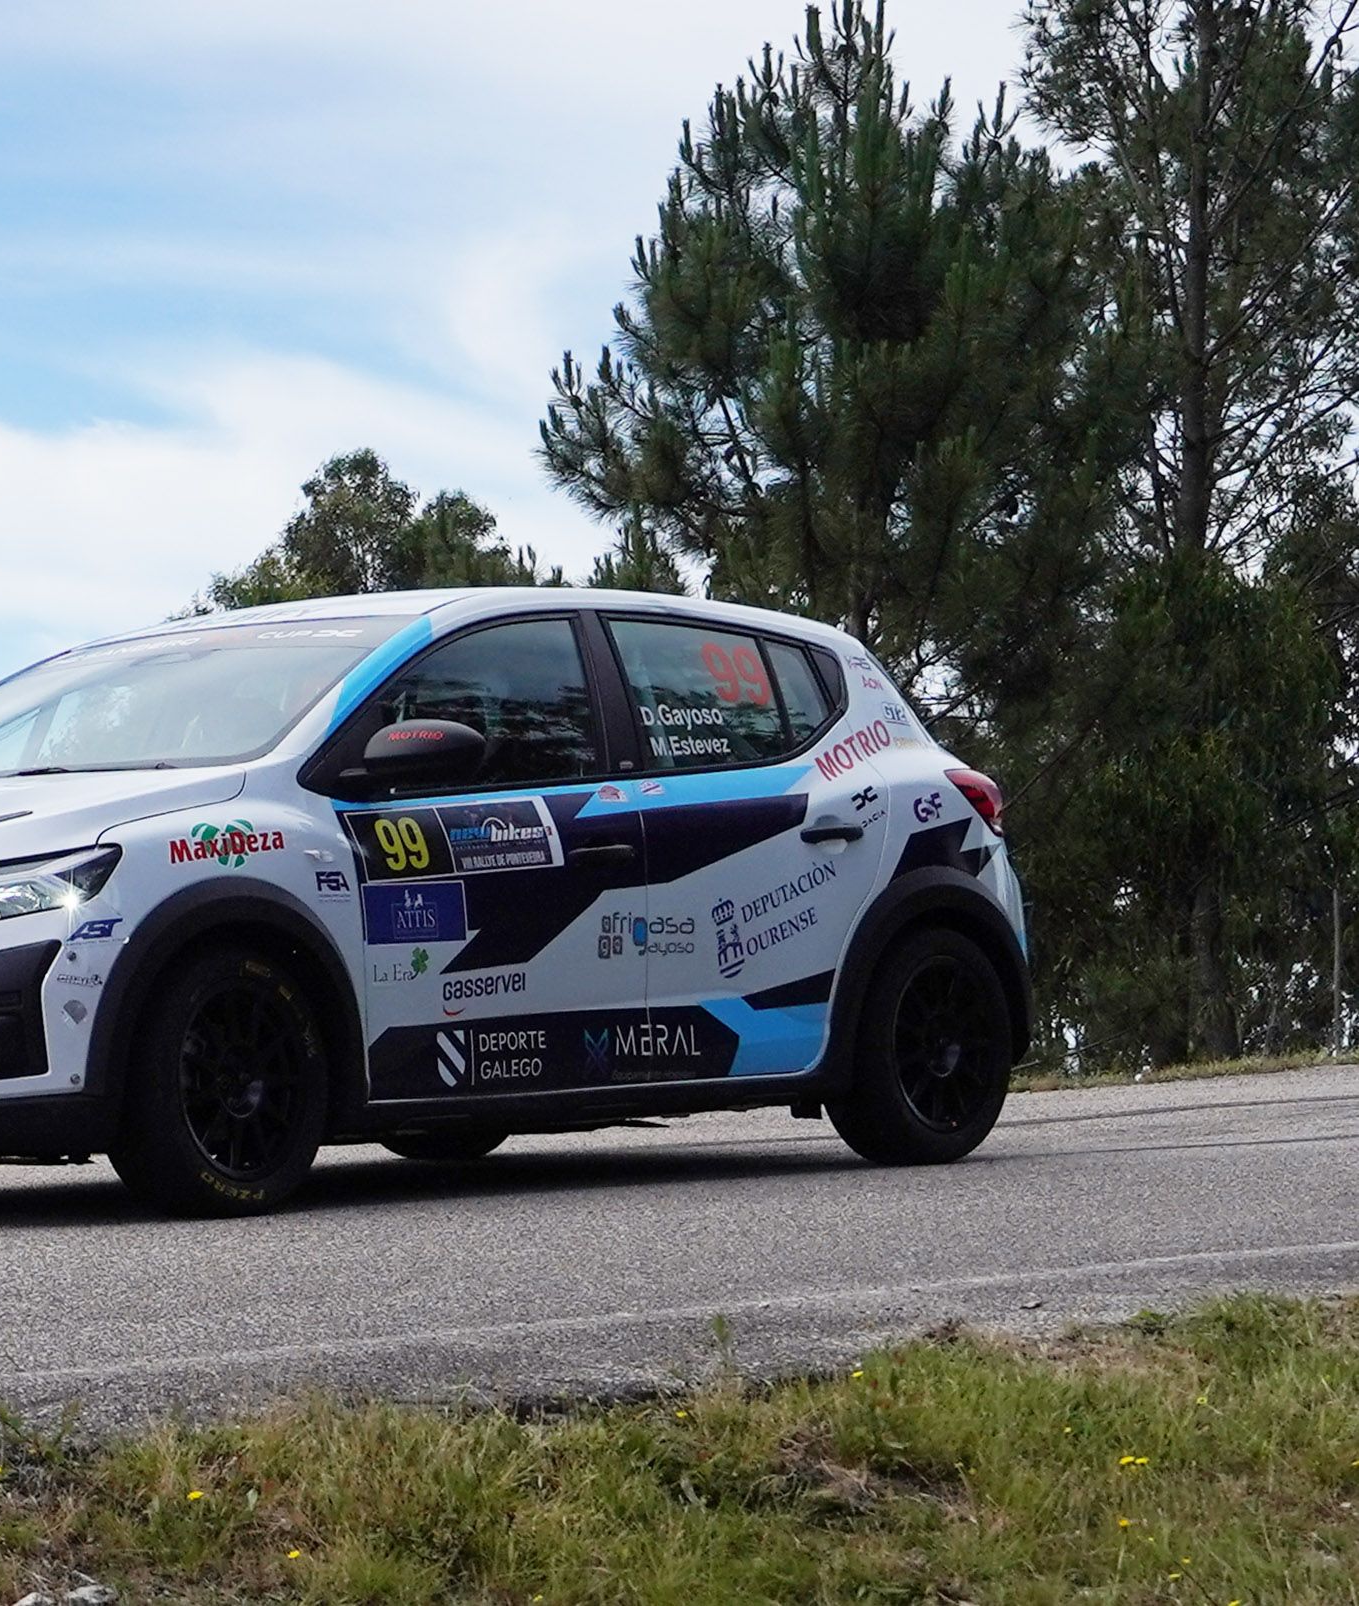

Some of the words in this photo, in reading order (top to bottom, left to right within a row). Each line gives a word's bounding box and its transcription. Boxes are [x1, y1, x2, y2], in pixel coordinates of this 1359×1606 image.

[257, 630, 311, 641] CUP
[700, 642, 771, 707] 99
[639, 703, 724, 731] D.Gayoso
[388, 729, 446, 742] MOTRIO
[649, 735, 732, 757] M.Estevez
[814, 720, 891, 782] MOTRIO
[168, 830, 286, 865] MaxiDeza
[373, 817, 430, 871] 99
[397, 909, 436, 929] ATTIS
[746, 906, 819, 956] OURENSE
[373, 965, 388, 983] La
[479, 1031, 547, 1053] DEPORTE
[480, 1059, 543, 1080] GALEGO
